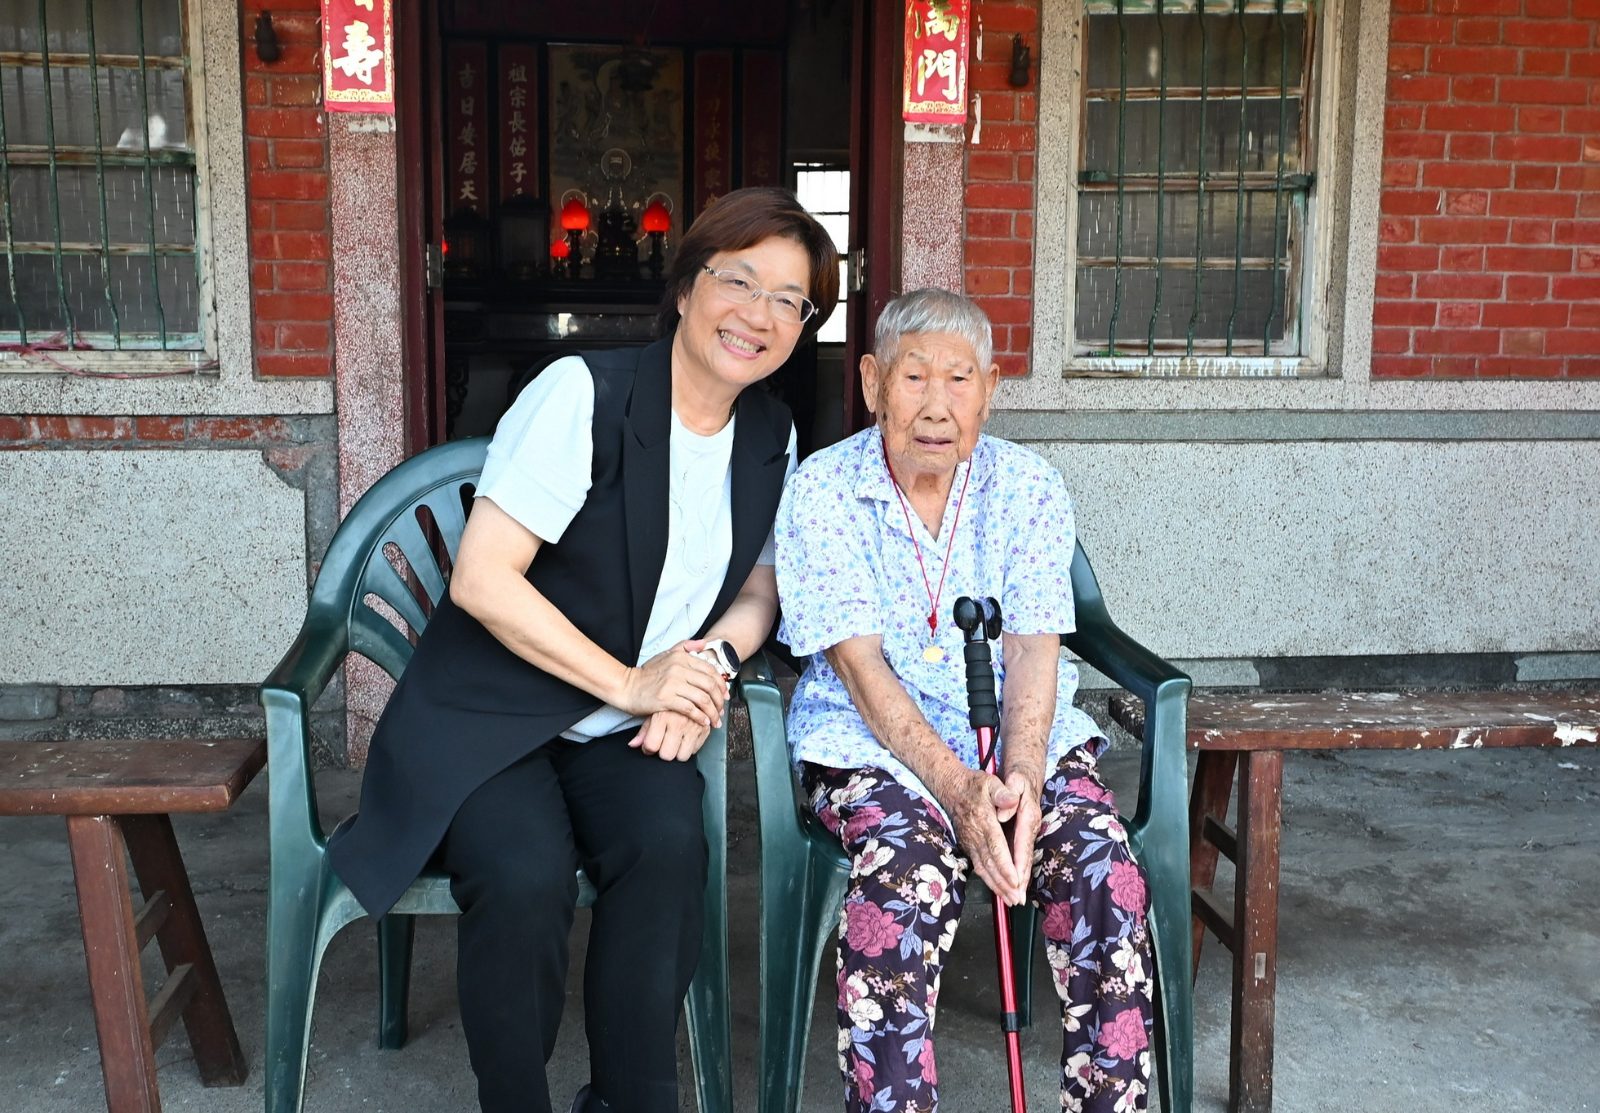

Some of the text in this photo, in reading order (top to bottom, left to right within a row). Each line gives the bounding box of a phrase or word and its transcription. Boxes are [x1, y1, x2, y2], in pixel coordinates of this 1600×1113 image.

[507, 63, 528, 198] 祖宗長佑子
